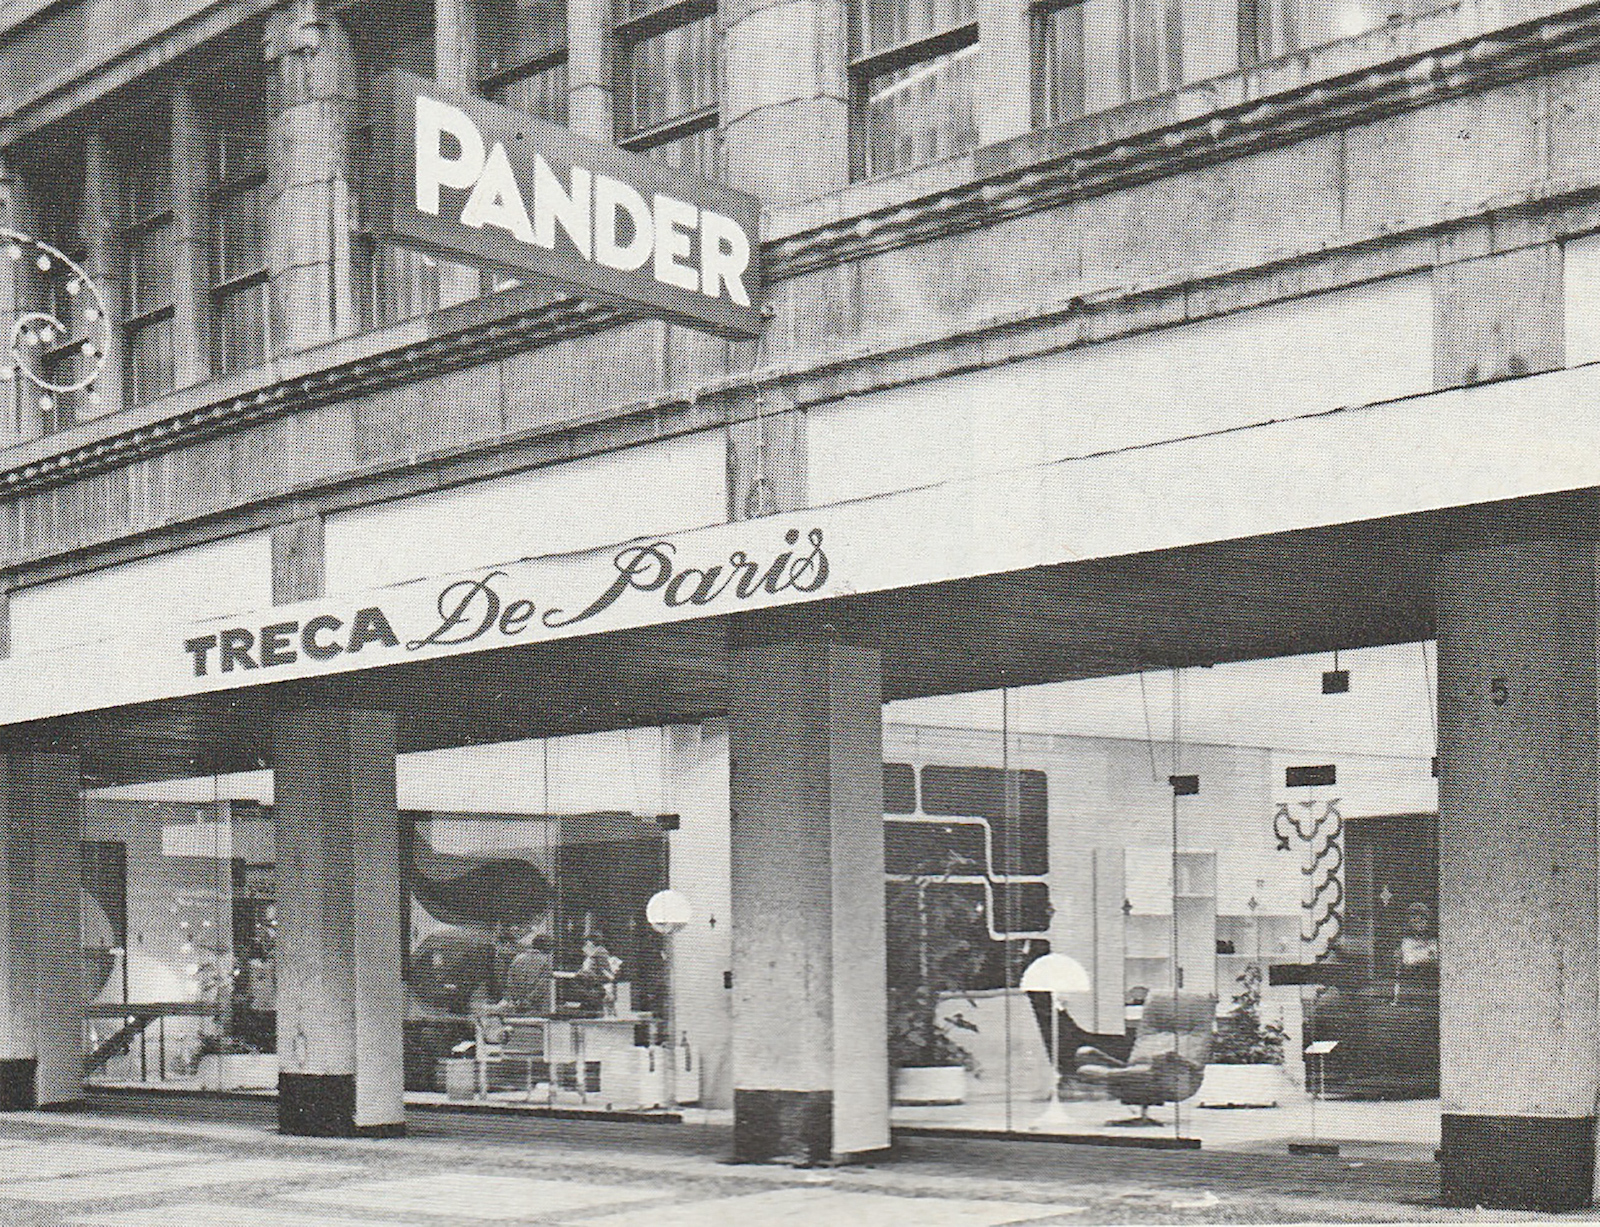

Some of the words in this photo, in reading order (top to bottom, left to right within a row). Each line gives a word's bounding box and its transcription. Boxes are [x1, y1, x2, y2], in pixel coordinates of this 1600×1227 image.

[415, 95, 752, 307] PANDER
[185, 606, 400, 676] TRECA
[406, 571, 535, 651] De
[543, 528, 830, 629] Paris
[1491, 678, 1509, 706] 5
